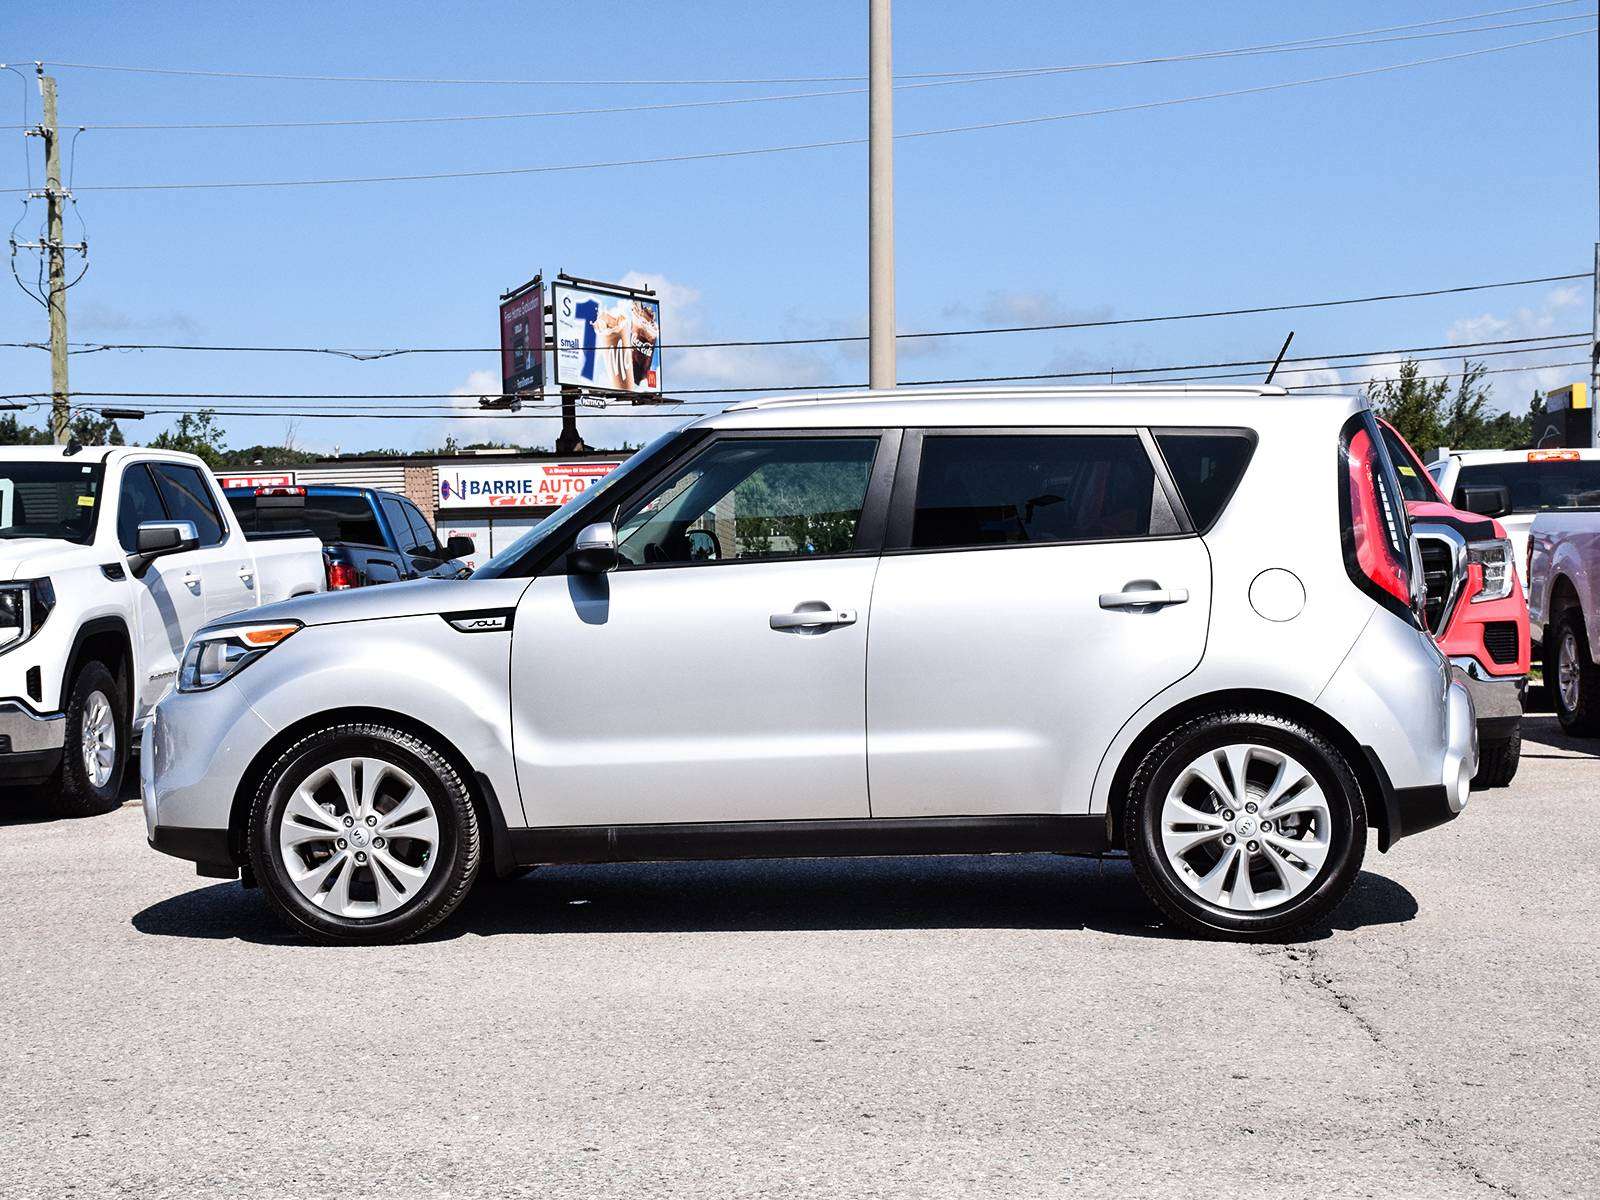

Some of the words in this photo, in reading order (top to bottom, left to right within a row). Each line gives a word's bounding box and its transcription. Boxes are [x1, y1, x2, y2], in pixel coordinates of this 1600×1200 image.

[560, 338, 580, 349] small
[470, 480, 532, 495] BARRIE
[539, 479, 585, 493] AUTO
